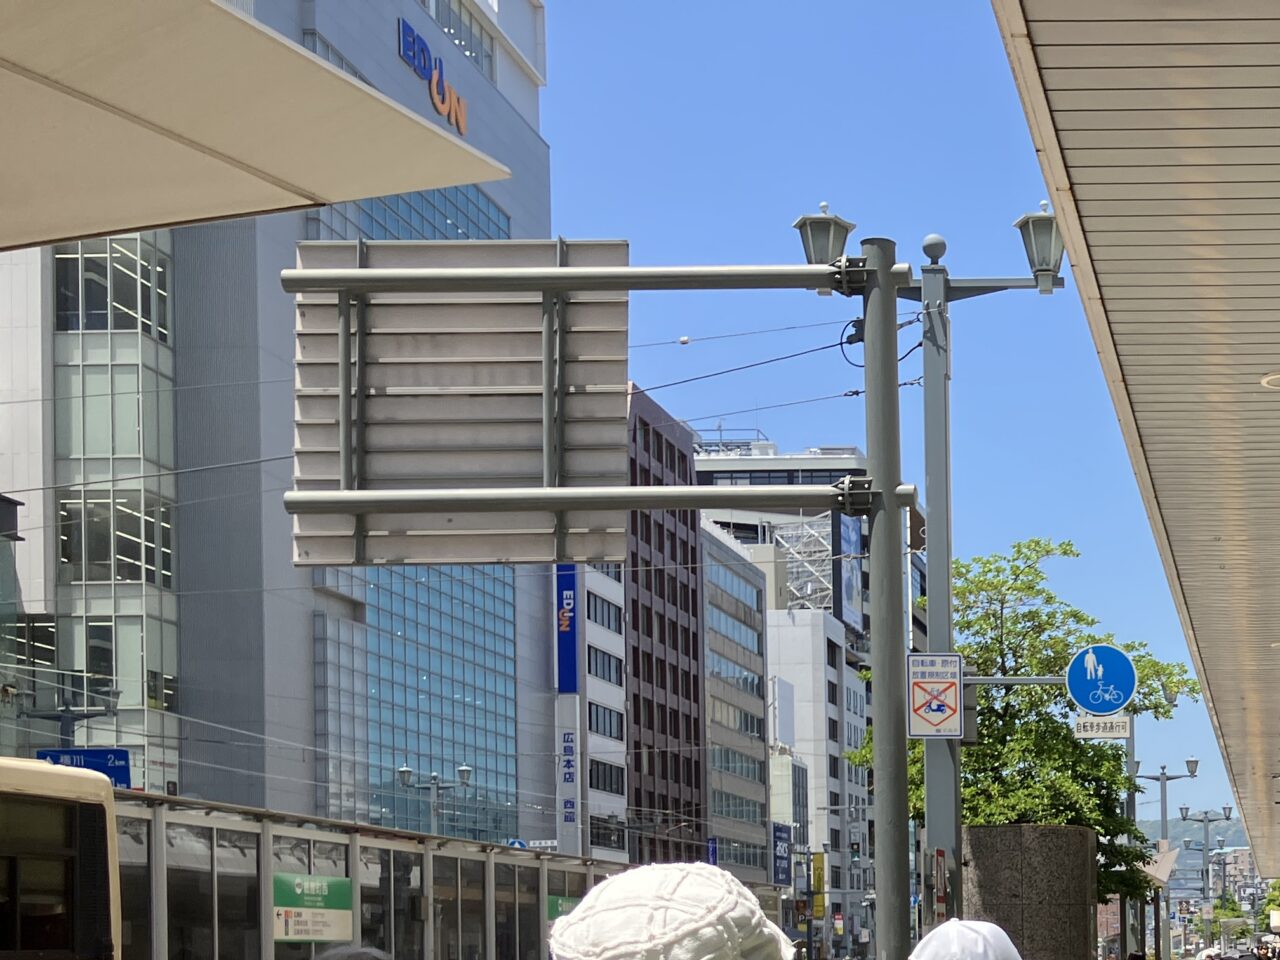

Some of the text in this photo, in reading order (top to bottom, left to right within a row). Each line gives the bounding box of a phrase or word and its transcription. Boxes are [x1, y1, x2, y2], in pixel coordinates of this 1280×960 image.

[559, 590, 574, 631] EDION
[563, 732, 575, 783] 広島本店
